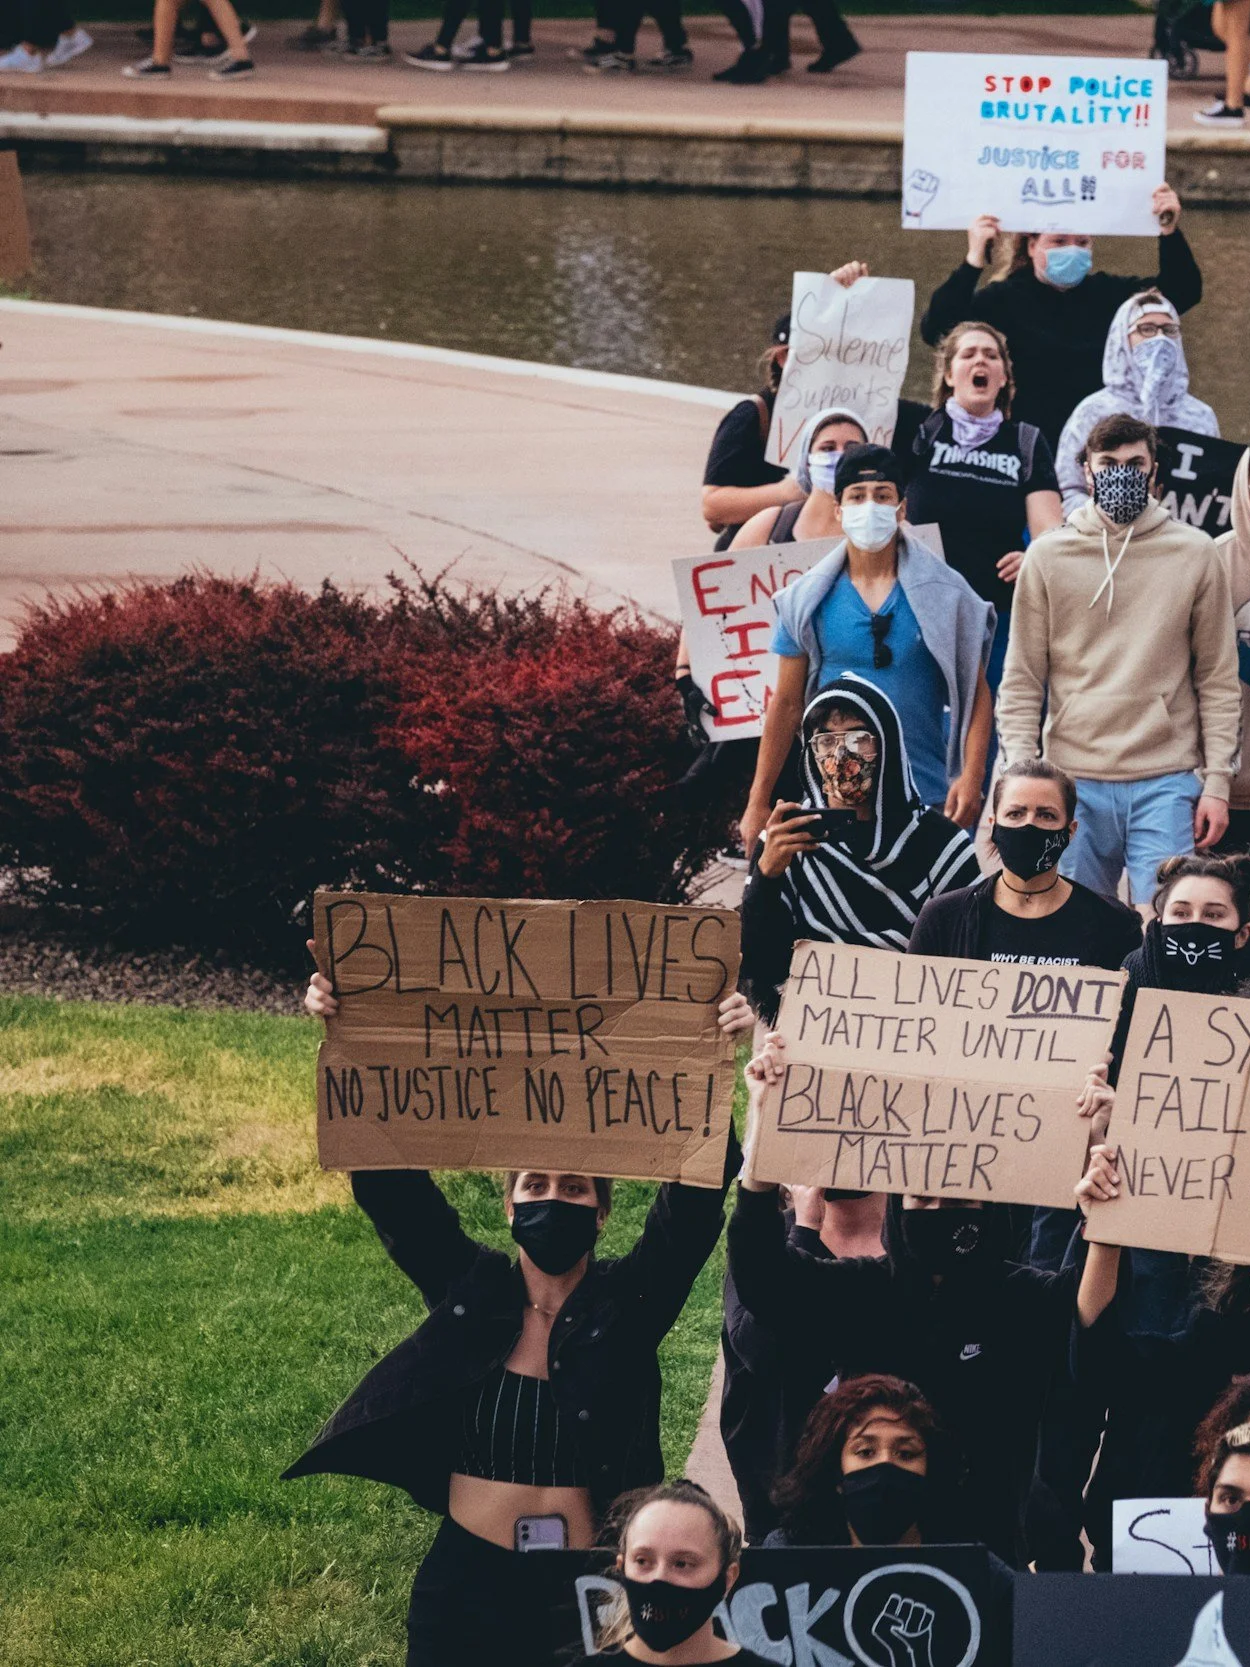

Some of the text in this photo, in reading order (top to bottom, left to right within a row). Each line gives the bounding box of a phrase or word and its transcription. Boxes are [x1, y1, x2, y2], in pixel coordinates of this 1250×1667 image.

[984, 75, 1052, 93] STOP
[1101, 151, 1145, 170] FOR
[797, 291, 905, 374] Silence
[784, 368, 891, 412] Supports
[930, 440, 1021, 481] THRASHER
[1171, 443, 1203, 480] I
[1161, 487, 1232, 528] AN'T
[325, 899, 728, 1005] BLACK LIVES
[790, 950, 876, 999] ALL
[895, 960, 1000, 1010] LIVES
[991, 952, 1018, 963] WHY
[1019, 955, 1035, 965] BE
[425, 1003, 609, 1060] MATTER
[799, 1003, 1077, 1063] MATTER UNTIL
[1143, 1003, 1173, 1063] A
[326, 1065, 714, 1138] NO JUSTICE NO PEACE!
[777, 1063, 1042, 1142] BLACK LIVES
[1133, 1071, 1247, 1135] FAIL
[831, 1132, 999, 1191] MATTER
[1115, 1144, 1235, 1201] NEVER
[1128, 1508, 1216, 1576] St
[575, 1575, 855, 1667] BCK
